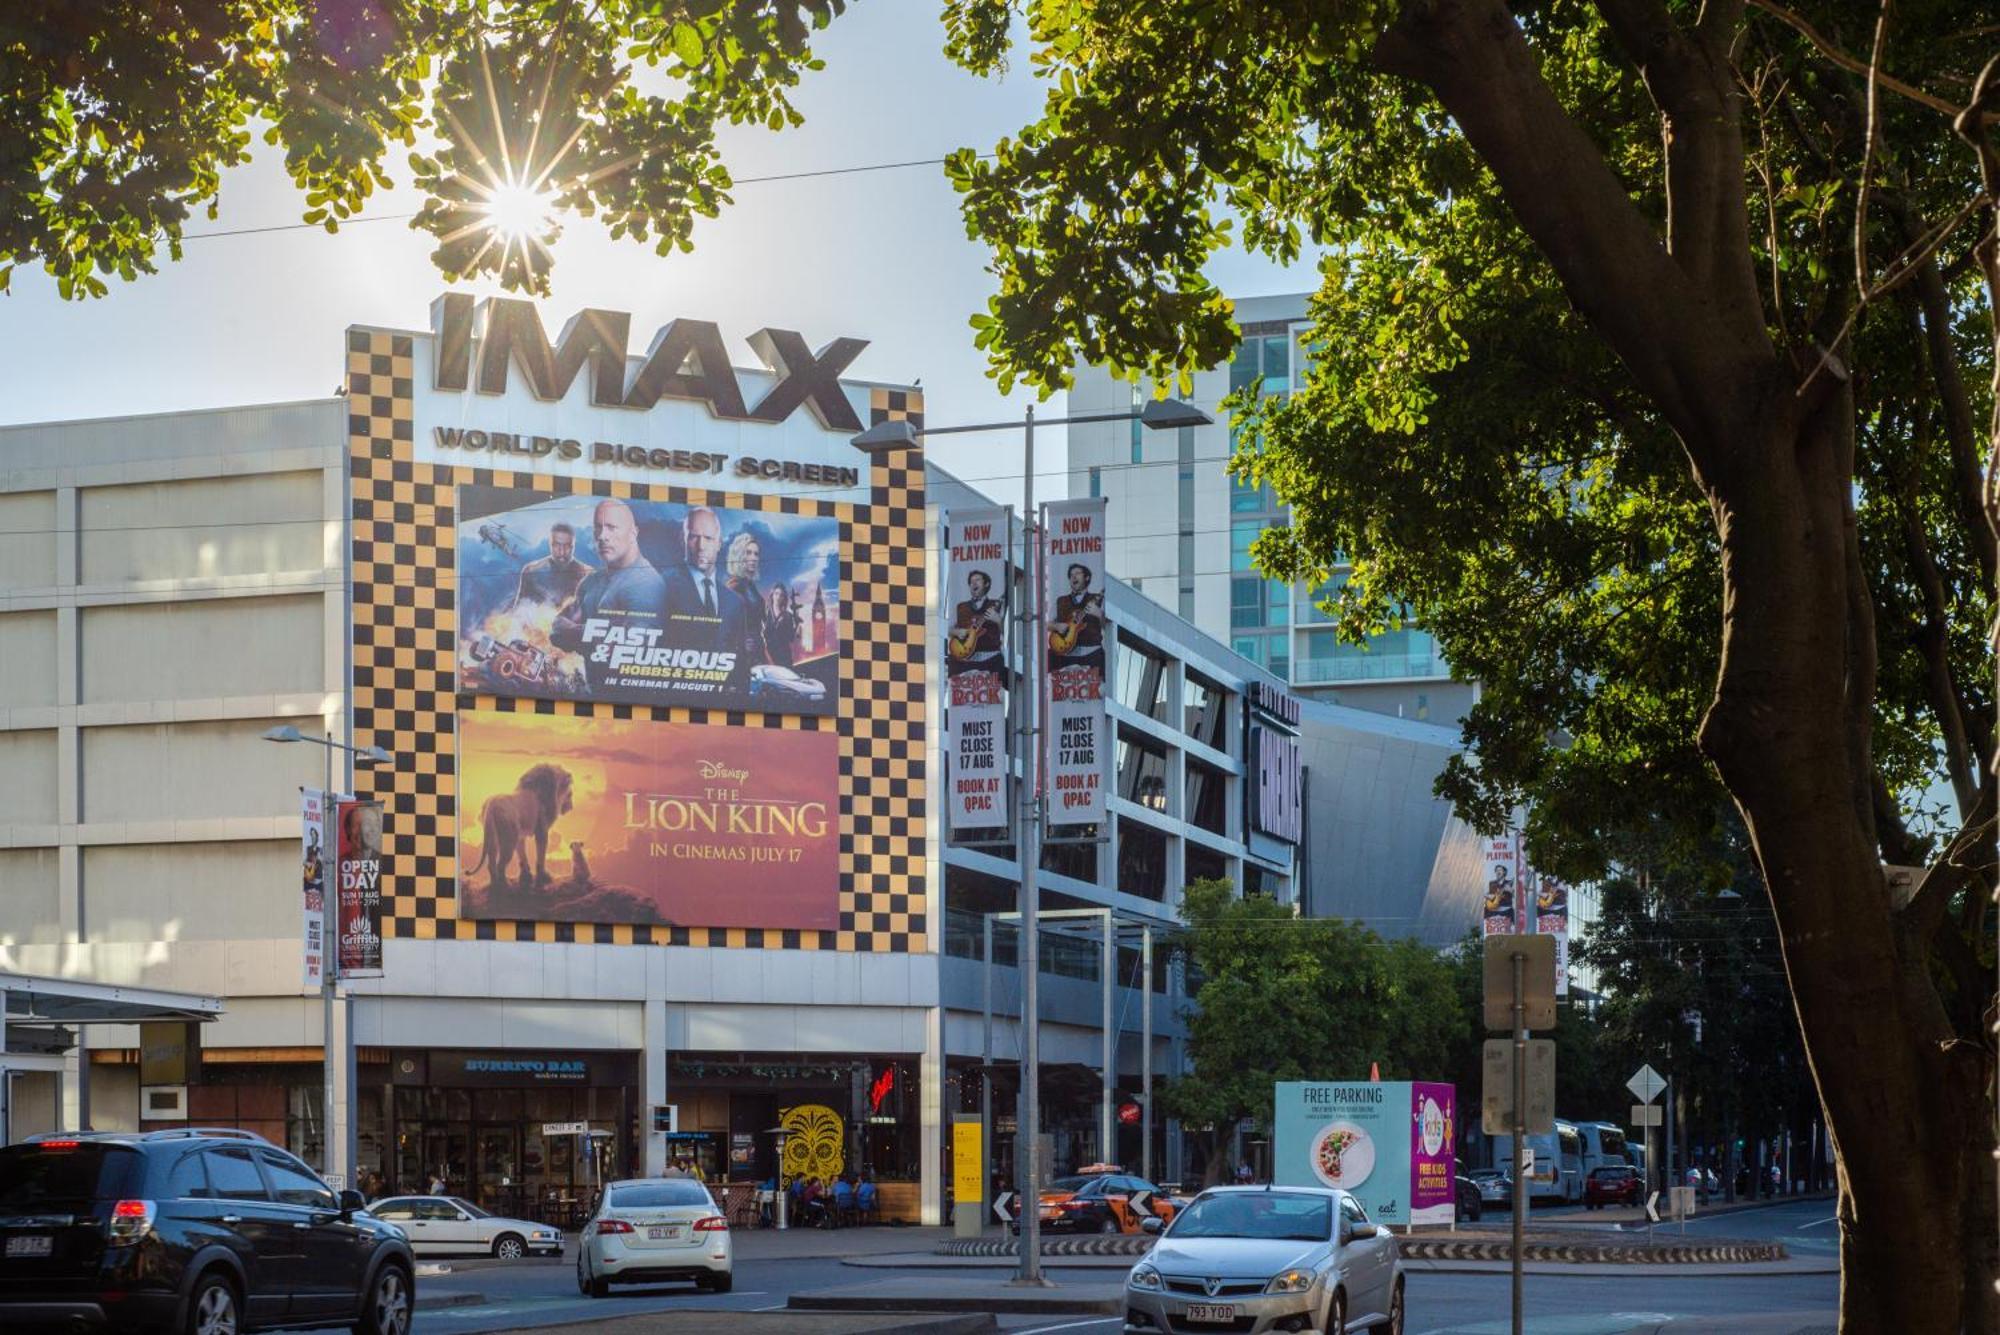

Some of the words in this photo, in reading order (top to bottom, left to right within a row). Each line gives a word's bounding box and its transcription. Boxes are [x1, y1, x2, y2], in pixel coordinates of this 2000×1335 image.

[430, 291, 870, 432] IMAX
[433, 426, 581, 460] WORLD'S
[591, 442, 729, 475] BIGGEST
[735, 456, 859, 488] SCREEN
[963, 524, 992, 542] NOW
[1062, 516, 1091, 535] NOW
[952, 543, 1002, 562] PLAYING
[1051, 536, 1102, 555] PLAYING
[581, 618, 663, 647] FAST
[609, 644, 737, 672] FURIOUS
[619, 664, 672, 678] HOBBS
[672, 667, 683, 679] &
[684, 668, 730, 682] SHAW
[605, 677, 617, 685] IN
[620, 679, 670, 689] CINEMAS
[672, 681, 715, 692] AUGUST
[1051, 682, 1102, 701] ROCK
[951, 687, 1003, 706] ROCK
[961, 721, 993, 737] MUST
[1062, 716, 1094, 732] MUST
[960, 737, 994, 753] CLOSE
[1060, 733, 1094, 748] CLOSE
[960, 755, 971, 770] 17
[972, 754, 994, 769] AUG
[1059, 751, 1071, 766] 17
[1073, 750, 1094, 765] AUG
[696, 759, 749, 785] Disney
[957, 779, 985, 793] BOOK
[987, 778, 1000, 792] AT
[1056, 774, 1083, 789] BOOK
[1086, 773, 1100, 789] AT
[704, 788, 740, 801] THE
[1063, 792, 1091, 810] QPAC
[964, 796, 992, 813] QPAC
[622, 792, 720, 834] LION
[726, 801, 830, 838] KING
[650, 842, 668, 856] IN
[673, 844, 746, 861] CINEMAS
[750, 847, 784, 864] JULY
[789, 848, 803, 864] 17
[1492, 841, 1508, 850] NOW
[1486, 851, 1513, 861] PLAYING
[341, 859, 380, 873] OPEN
[341, 872, 380, 890] DAY
[342, 934, 379, 945] Griffith
[464, 1060, 545, 1071] BURRITO
[547, 1060, 586, 1072] BAR
[1304, 1088, 1331, 1104] FREE
[1334, 1087, 1383, 1104] PARKING
[1378, 1199, 1397, 1213] eat
[1190, 1306, 1206, 1318] 793
